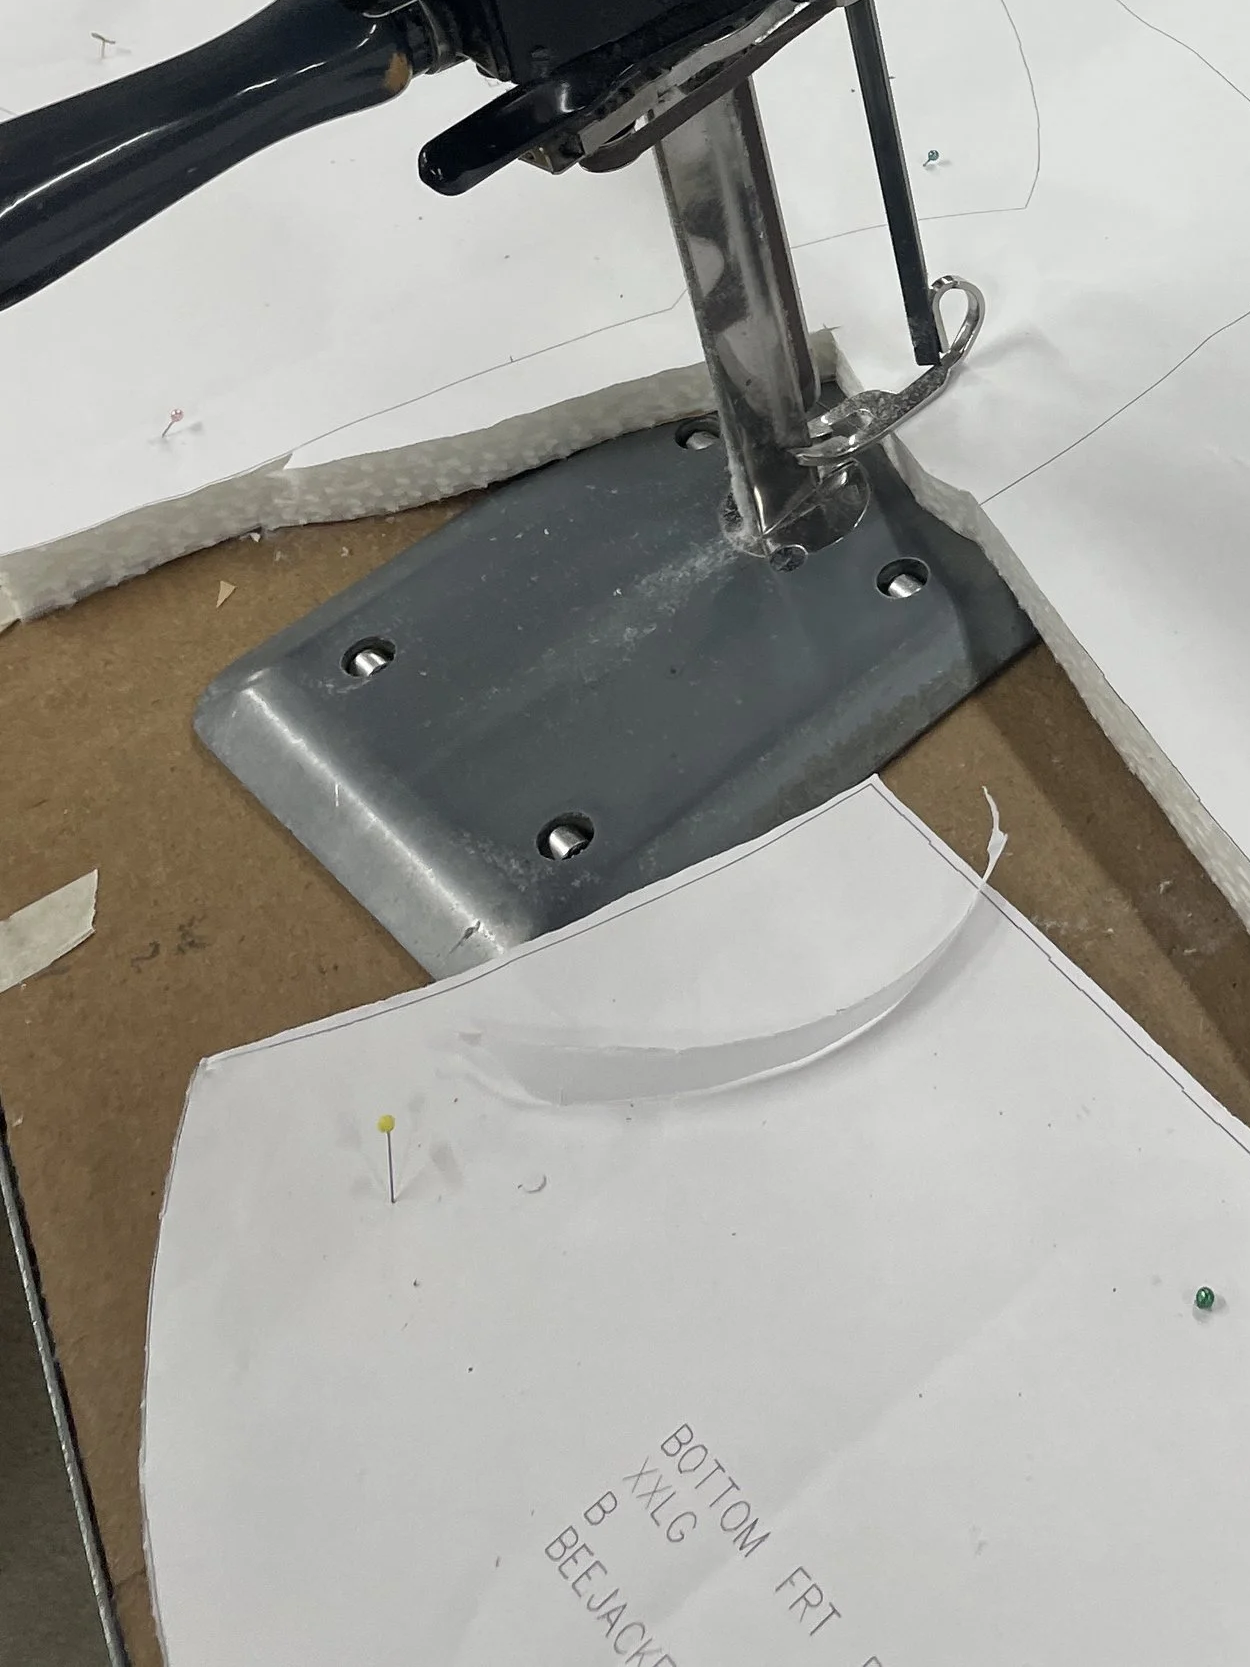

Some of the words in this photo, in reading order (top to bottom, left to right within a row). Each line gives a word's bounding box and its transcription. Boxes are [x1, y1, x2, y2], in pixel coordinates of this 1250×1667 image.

[583, 1491, 618, 1527] B
[622, 1456, 697, 1543] XXLG
[660, 1423, 771, 1558] BOTTOM
[775, 1566, 842, 1637] FRT
